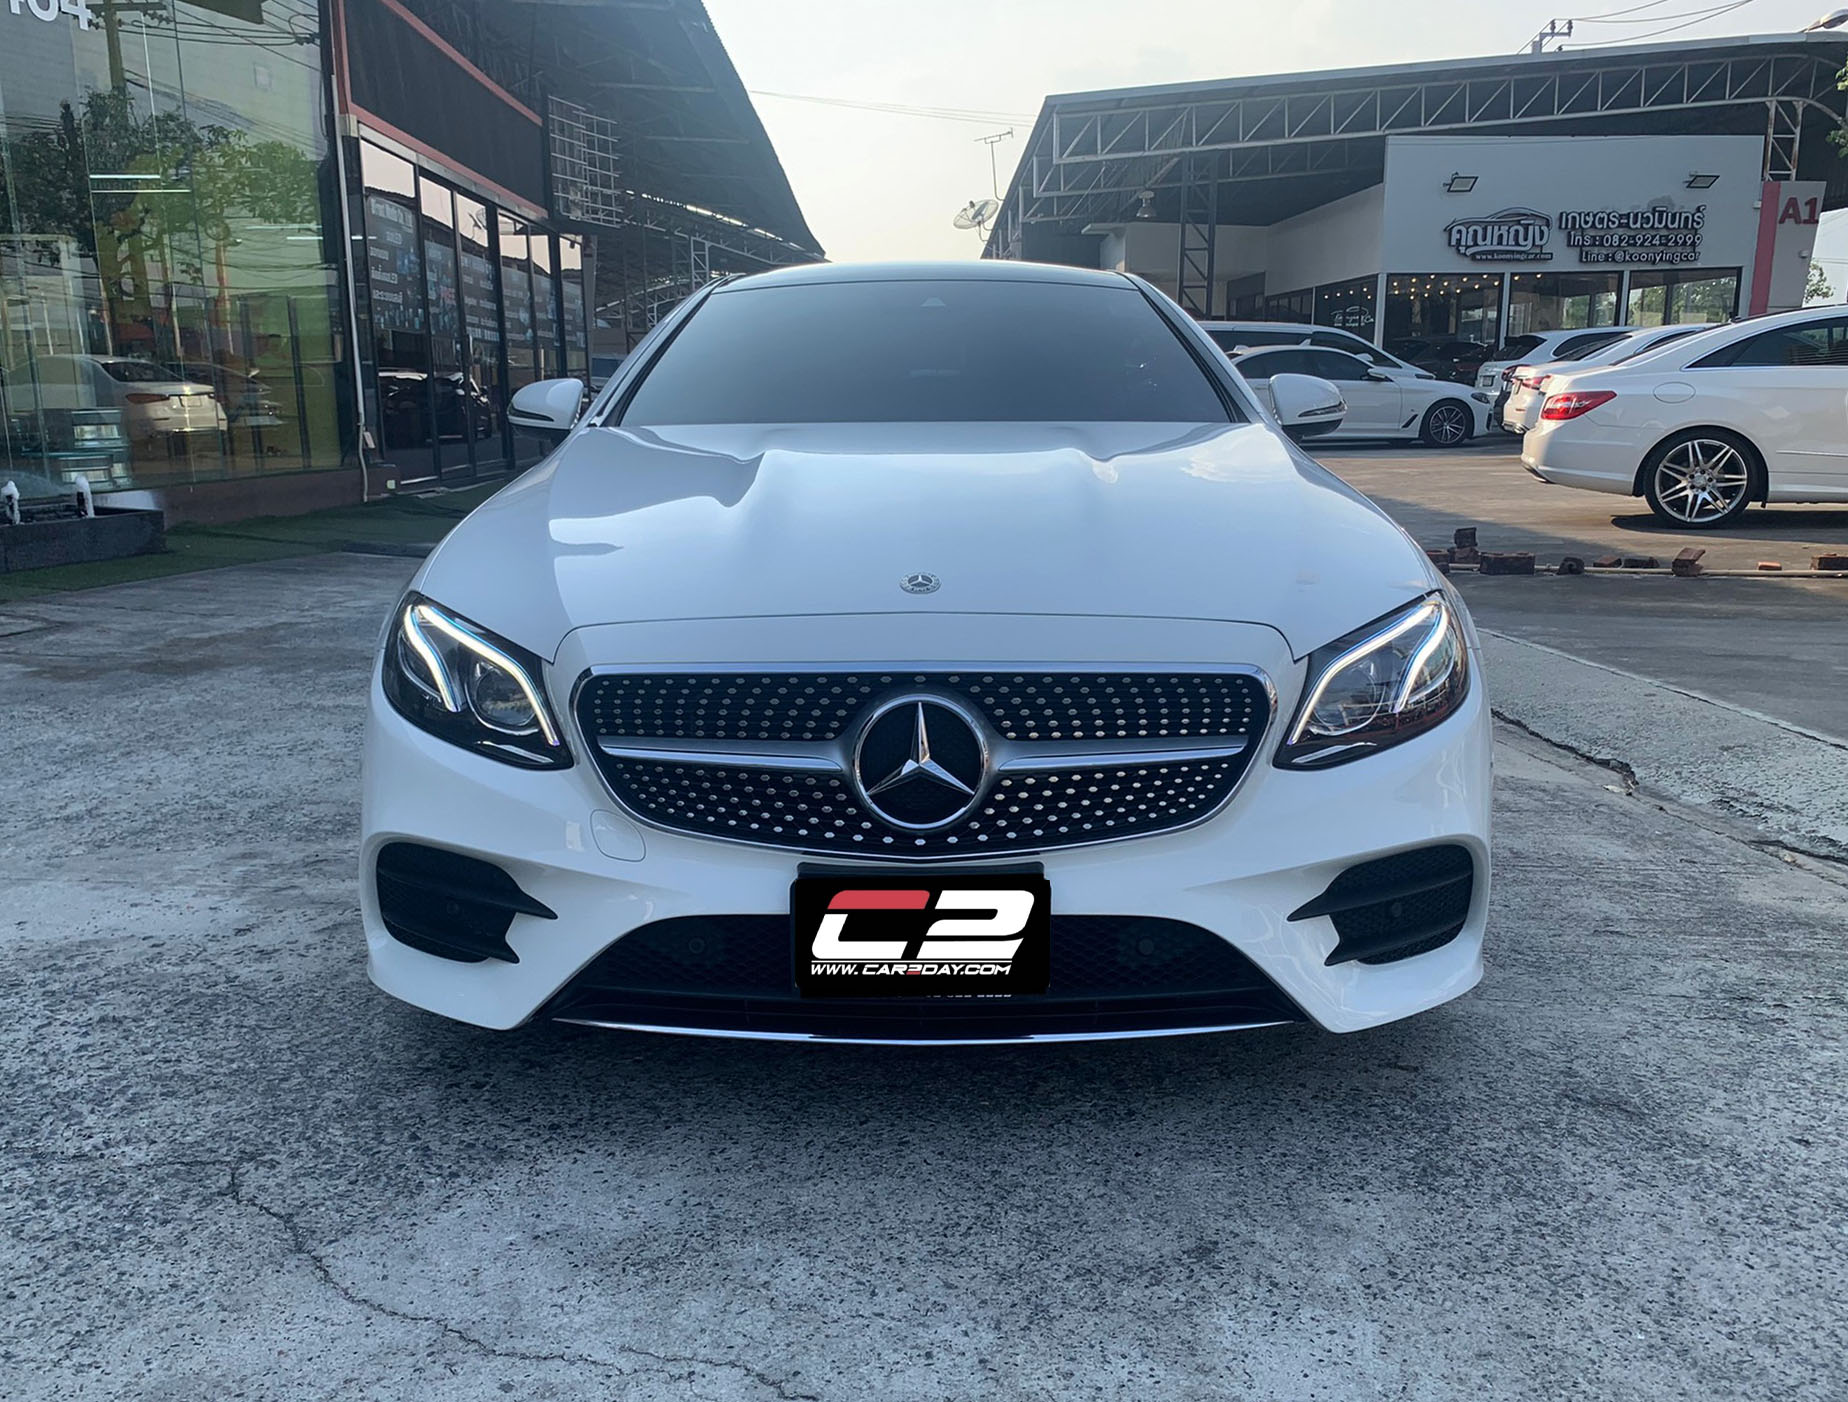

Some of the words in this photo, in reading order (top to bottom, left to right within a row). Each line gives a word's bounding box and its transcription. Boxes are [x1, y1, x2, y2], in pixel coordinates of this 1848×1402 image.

[1779, 197, 1820, 225] A1
[1450, 219, 1550, 256] คุณหญิง
[1603, 233, 1702, 247] 082-924-2999
[1614, 250, 1701, 266] @koonyingcar
